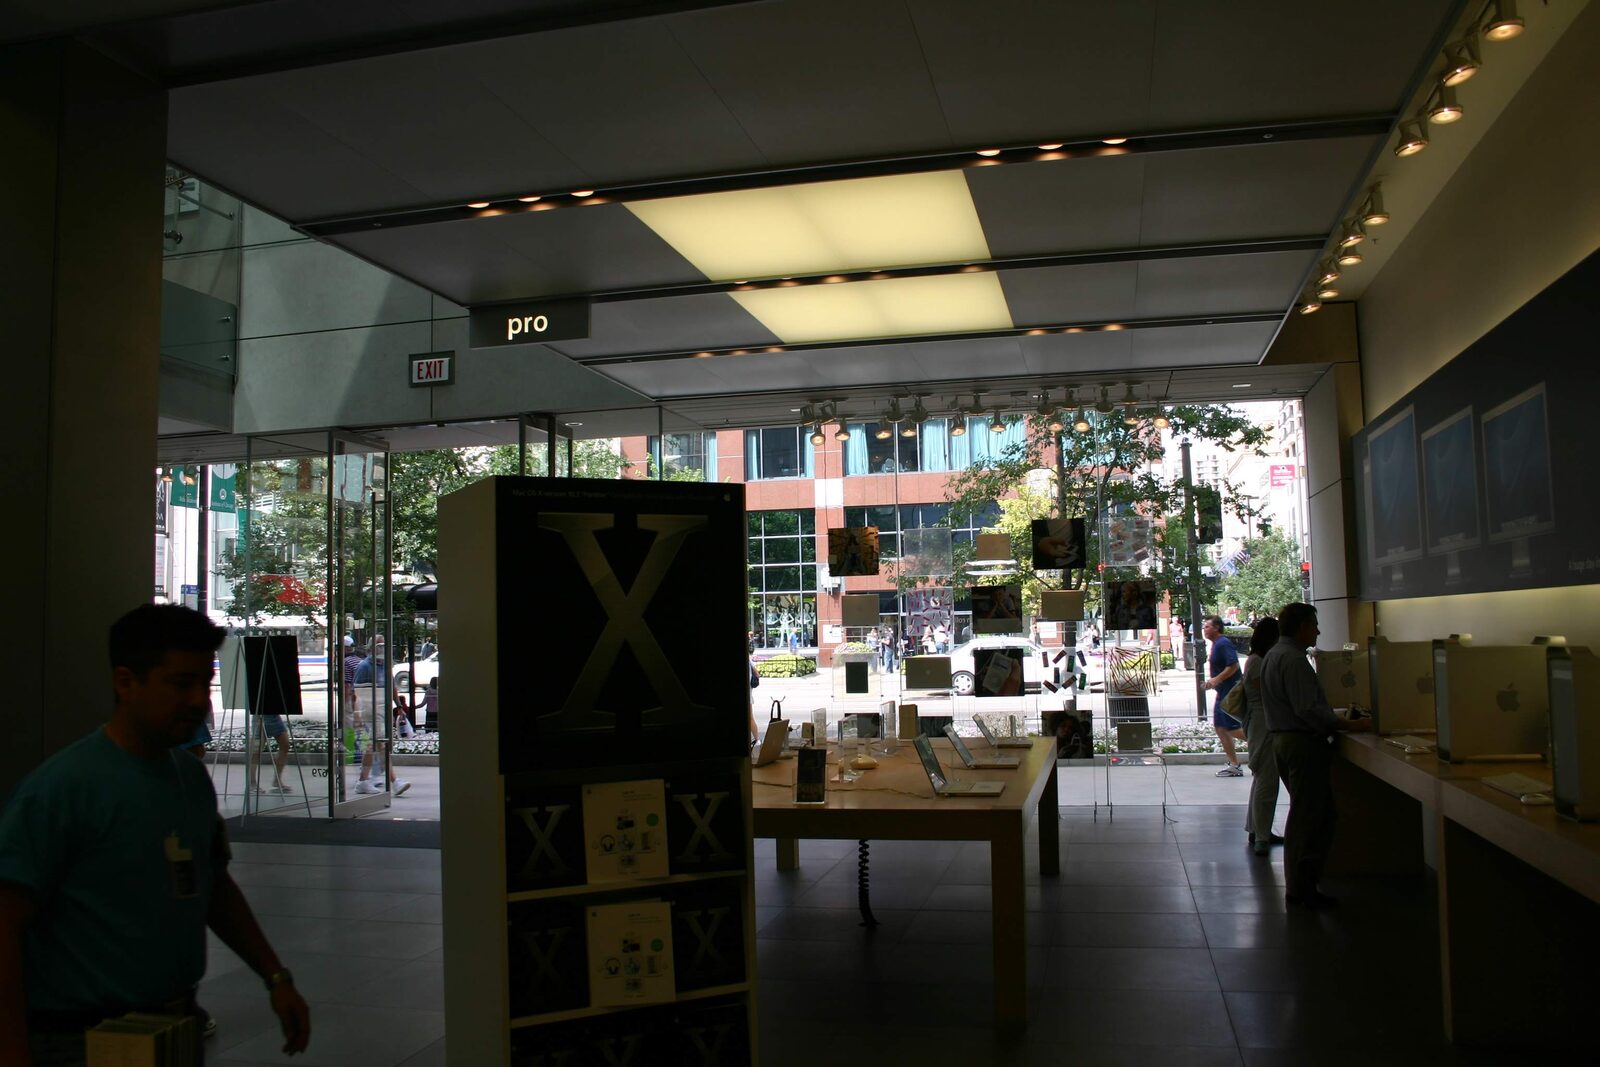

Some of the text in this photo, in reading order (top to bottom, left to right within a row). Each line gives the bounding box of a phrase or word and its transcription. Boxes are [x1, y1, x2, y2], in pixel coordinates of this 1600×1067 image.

[507, 315, 548, 340] pro
[417, 360, 444, 380] EXIT
[536, 511, 719, 736] X
[512, 803, 576, 880] X
[672, 791, 736, 864] X
[676, 906, 734, 977] X
